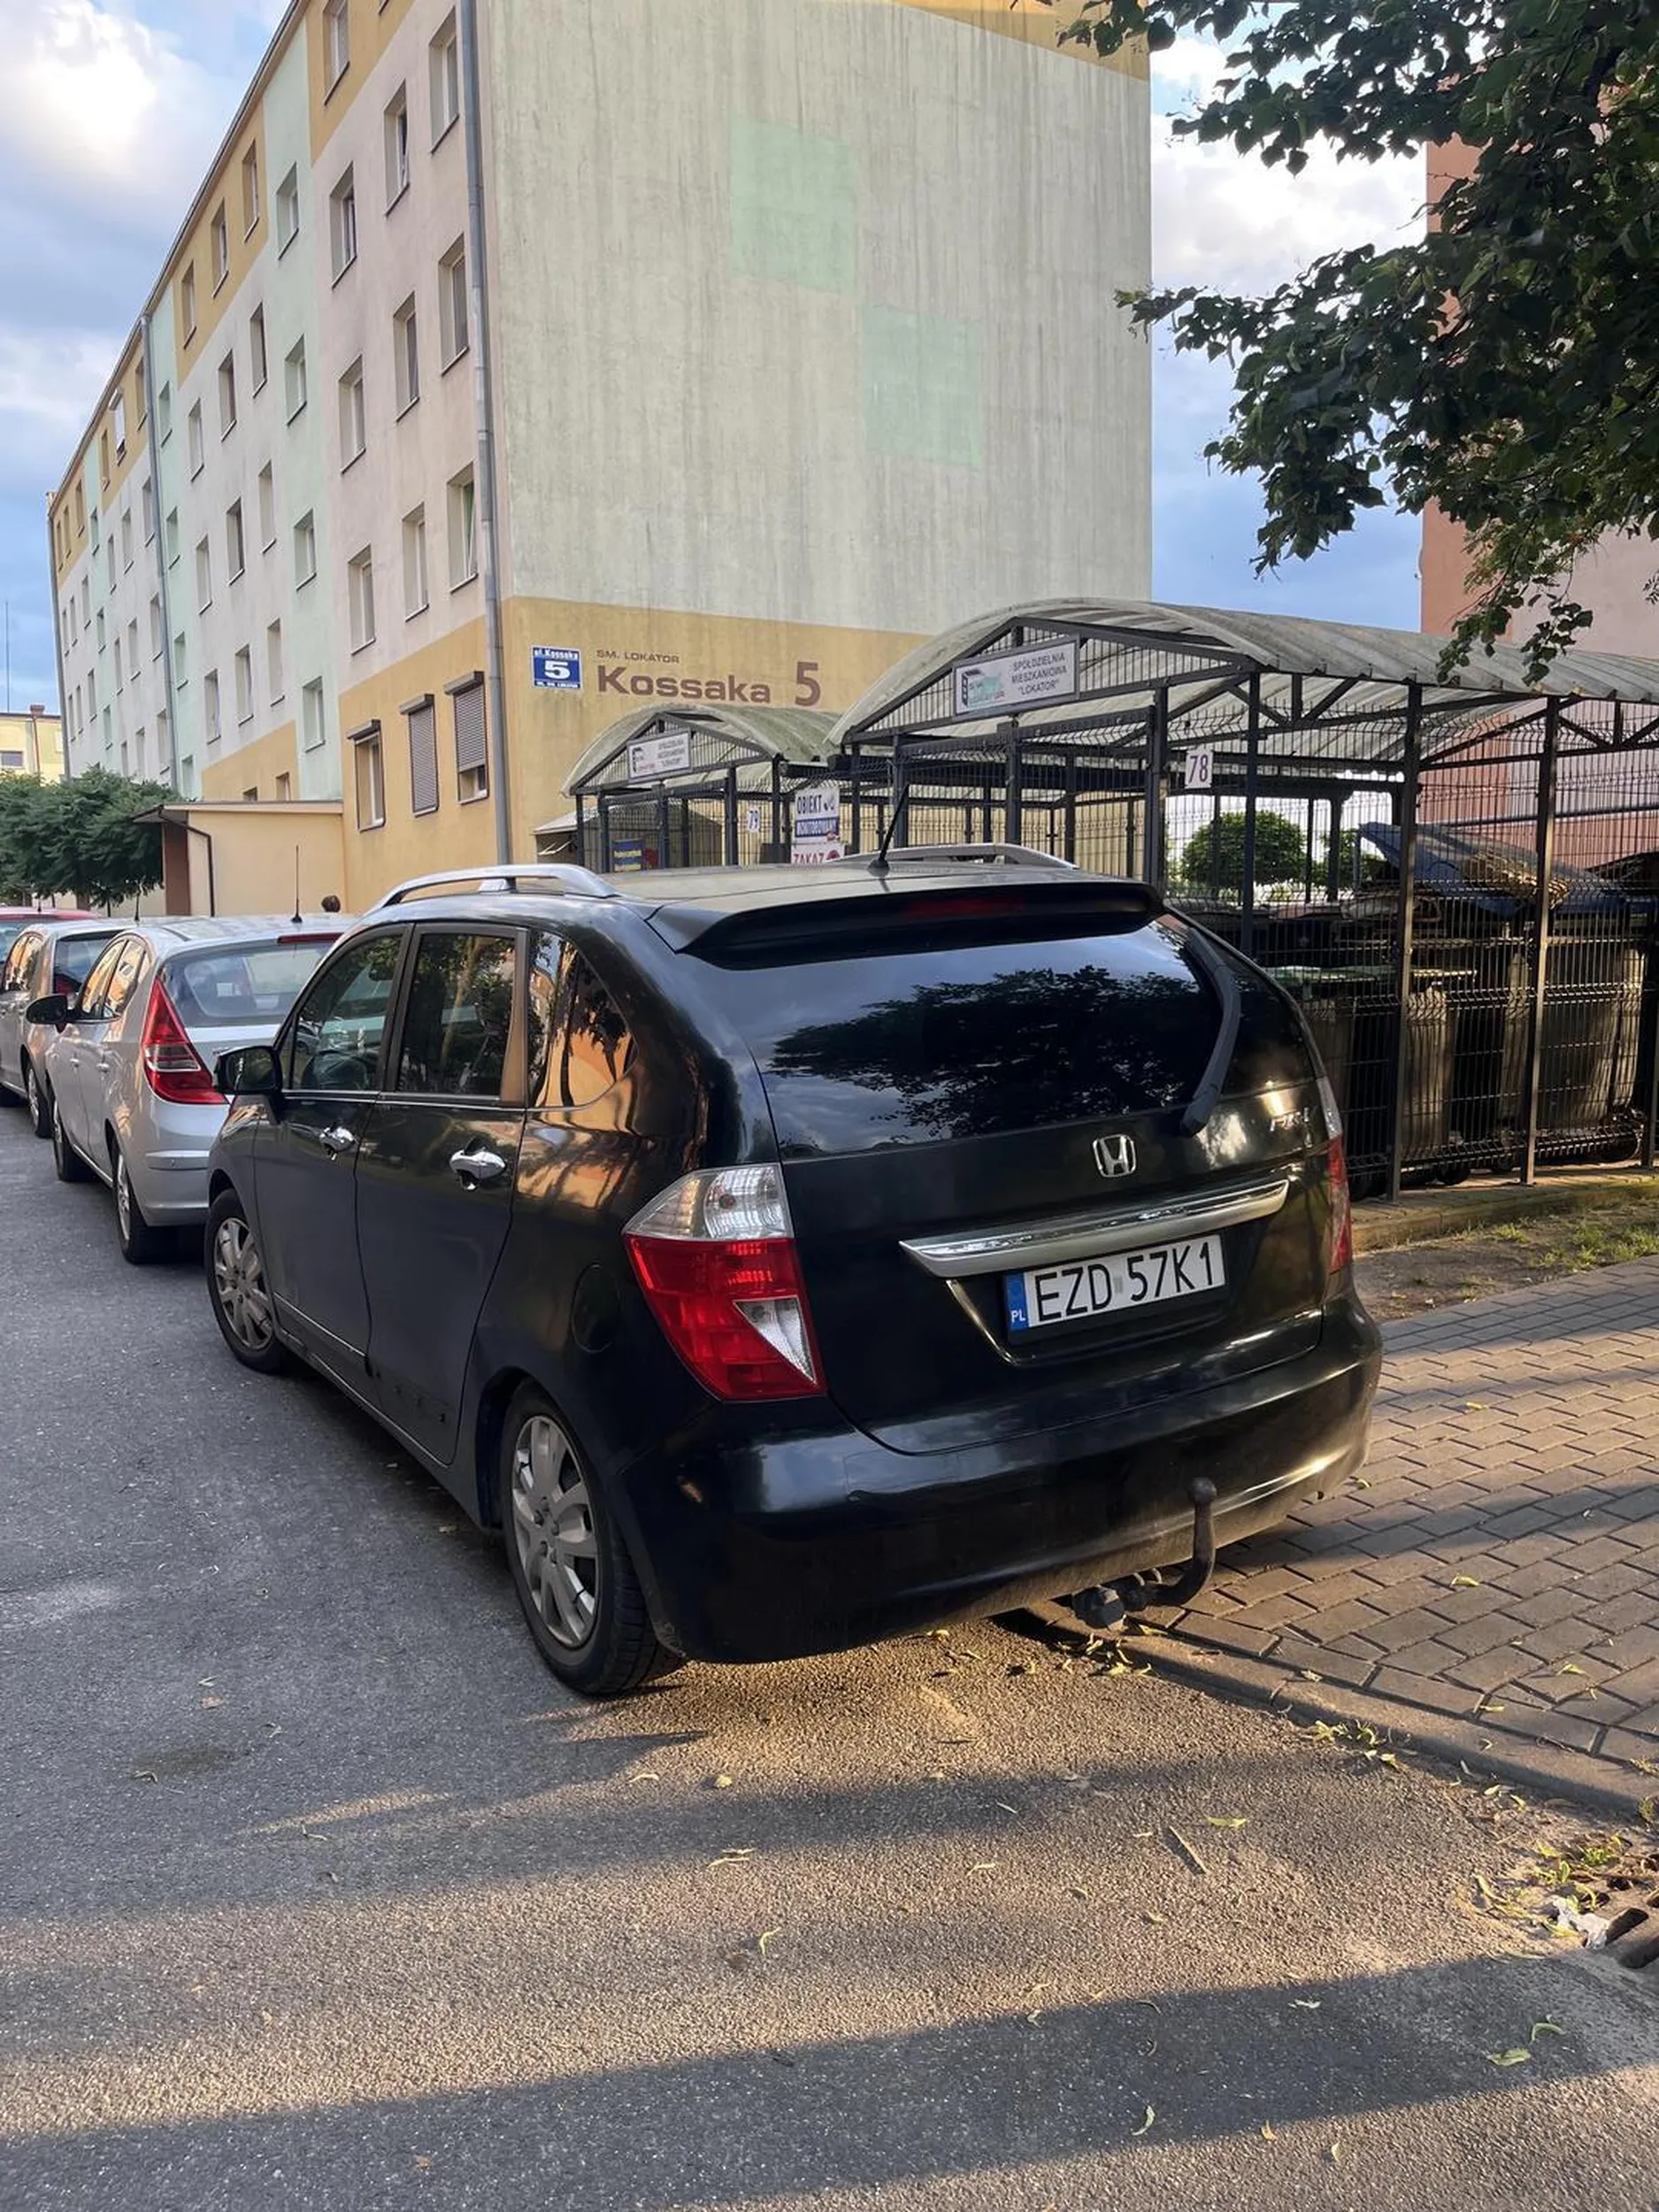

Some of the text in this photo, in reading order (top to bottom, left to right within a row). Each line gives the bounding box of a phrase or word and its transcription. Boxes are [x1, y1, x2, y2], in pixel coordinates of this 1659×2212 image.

[595, 649, 680, 664] SM. LOKATOR
[544, 660, 571, 680] 5
[596, 661, 821, 707] Kossaka 5
[1188, 754, 1210, 784] 78
[1034, 1241, 1214, 1322] EZD 57K1
[1010, 1310, 1026, 1324] PL
